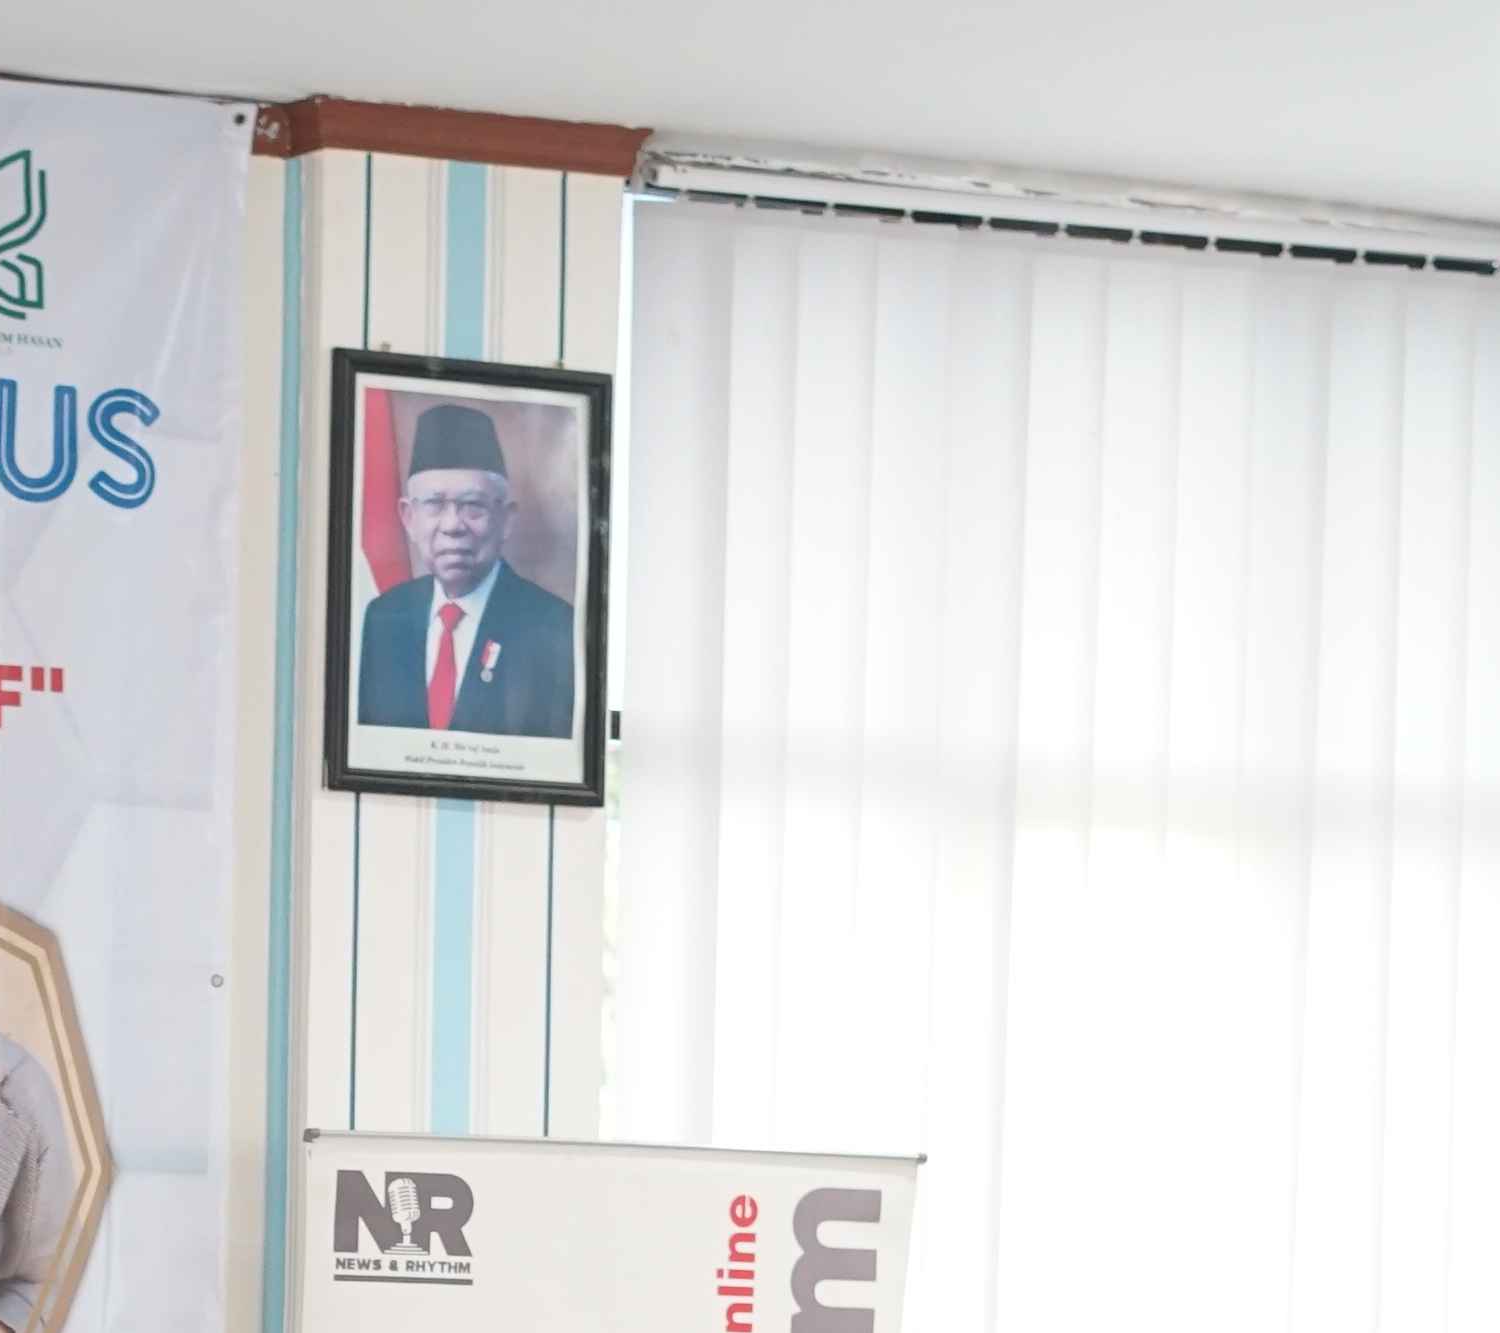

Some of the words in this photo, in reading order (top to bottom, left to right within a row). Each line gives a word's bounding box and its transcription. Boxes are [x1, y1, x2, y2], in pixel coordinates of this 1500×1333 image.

[335, 1258, 382, 1271] NEWS
[389, 1260, 398, 1272] &
[405, 1260, 472, 1275] RHYTHM
